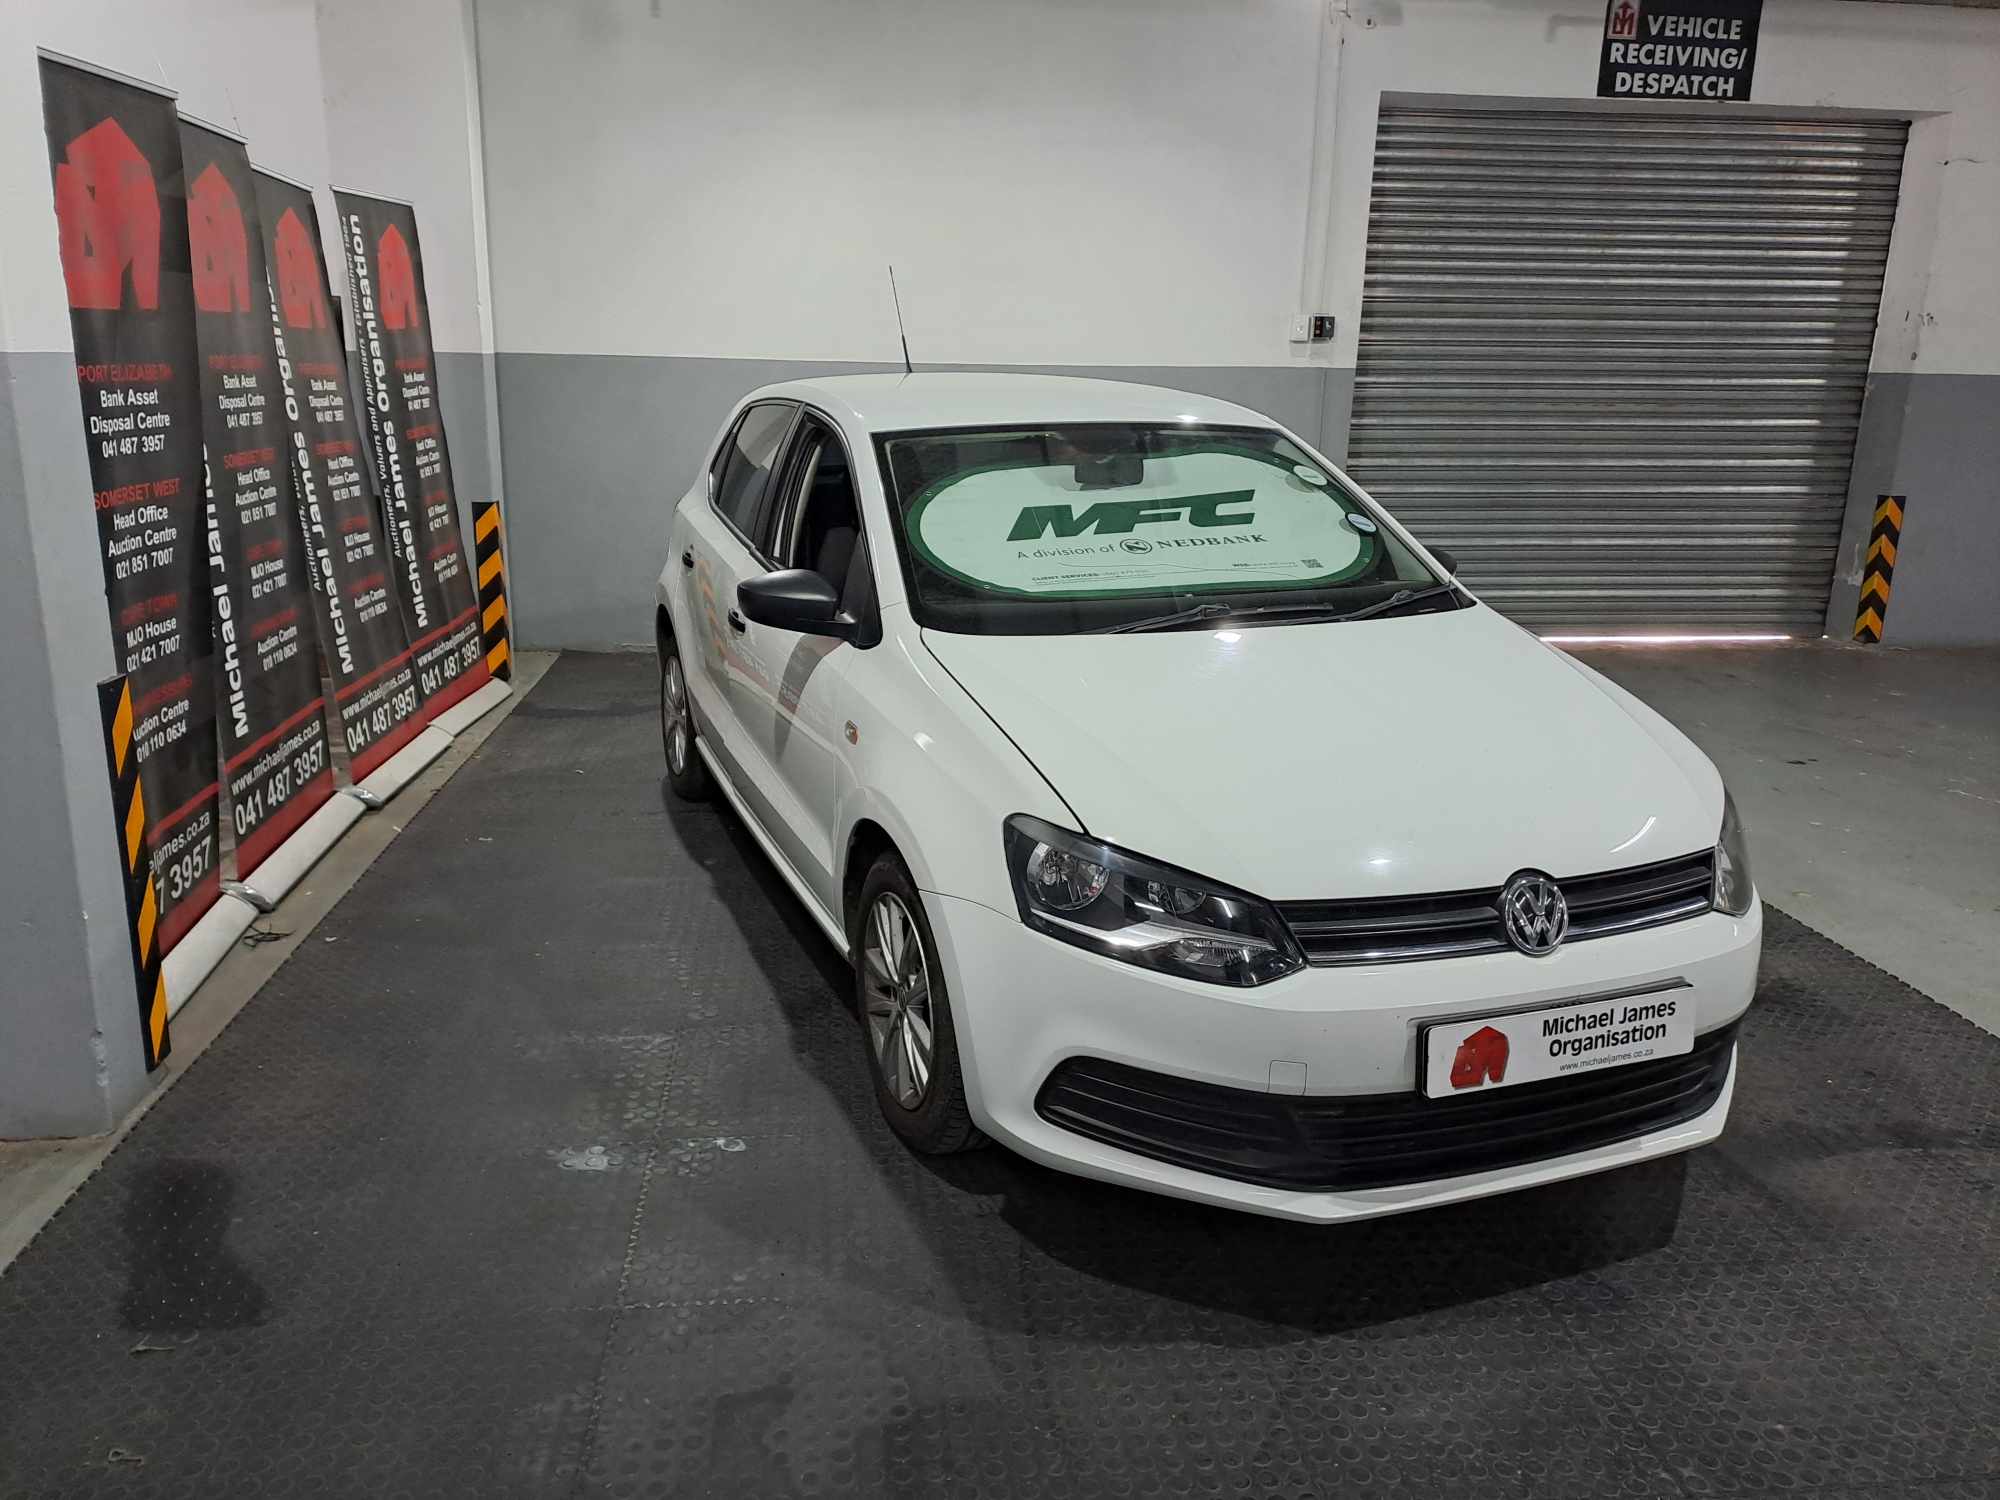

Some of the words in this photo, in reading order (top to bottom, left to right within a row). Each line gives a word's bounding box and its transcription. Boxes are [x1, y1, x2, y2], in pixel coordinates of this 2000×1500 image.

[1648, 15, 1743, 40] VEHICLE
[1609, 42, 1748, 70] RECEIVING/
[1614, 71, 1735, 97] DESPATCH
[78, 364, 107, 382] PORT
[100, 389, 125, 408] Bank
[127, 387, 159, 406] Asset
[90, 413, 134, 436] Disposal
[137, 411, 170, 429] Centre
[102, 439, 117, 458] 041
[120, 437, 137, 456] 487
[142, 434, 165, 453] 3957
[383, 420, 408, 513] James
[94, 482, 151, 510] SOMERSET
[152, 478, 180, 497] WEST
[293, 431, 326, 539] James
[113, 509, 136, 531] Head
[137, 505, 168, 524] Office
[1006, 489, 1256, 541] MFC
[108, 534, 142, 558] Auction
[144, 526, 177, 546] Centre
[1017, 550, 1029, 560] A
[1033, 545, 1095, 559] division
[1099, 542, 1115, 554] of
[1157, 534, 1268, 549] NEDBANK
[116, 560, 130, 579] 021
[132, 553, 147, 574] 851
[151, 547, 174, 568] 7007
[398, 519, 429, 628] Michael
[316, 548, 354, 675] Michael
[126, 626, 144, 649] MJO
[145, 617, 177, 639] House
[126, 652, 140, 673] 021
[141, 643, 157, 664] 421
[159, 634, 180, 656] 7007
[213, 584, 249, 738] Michael
[421, 665, 442, 695] 041
[443, 652, 461, 680] 487
[461, 635, 481, 667] 3957
[133, 714, 159, 741] uction
[160, 699, 190, 723] Centre
[346, 718, 371, 753] 041
[372, 703, 392, 735] 487
[391, 684, 418, 721] 3957
[150, 731, 165, 752] 110
[235, 789, 263, 835] 041
[267, 765, 290, 807] 487
[293, 739, 322, 785] 3957
[169, 835, 212, 899] 3957
[1542, 1008, 1615, 1037] Michael
[1618, 1001, 1676, 1025] James
[1549, 1023, 1667, 1057] Organisation
